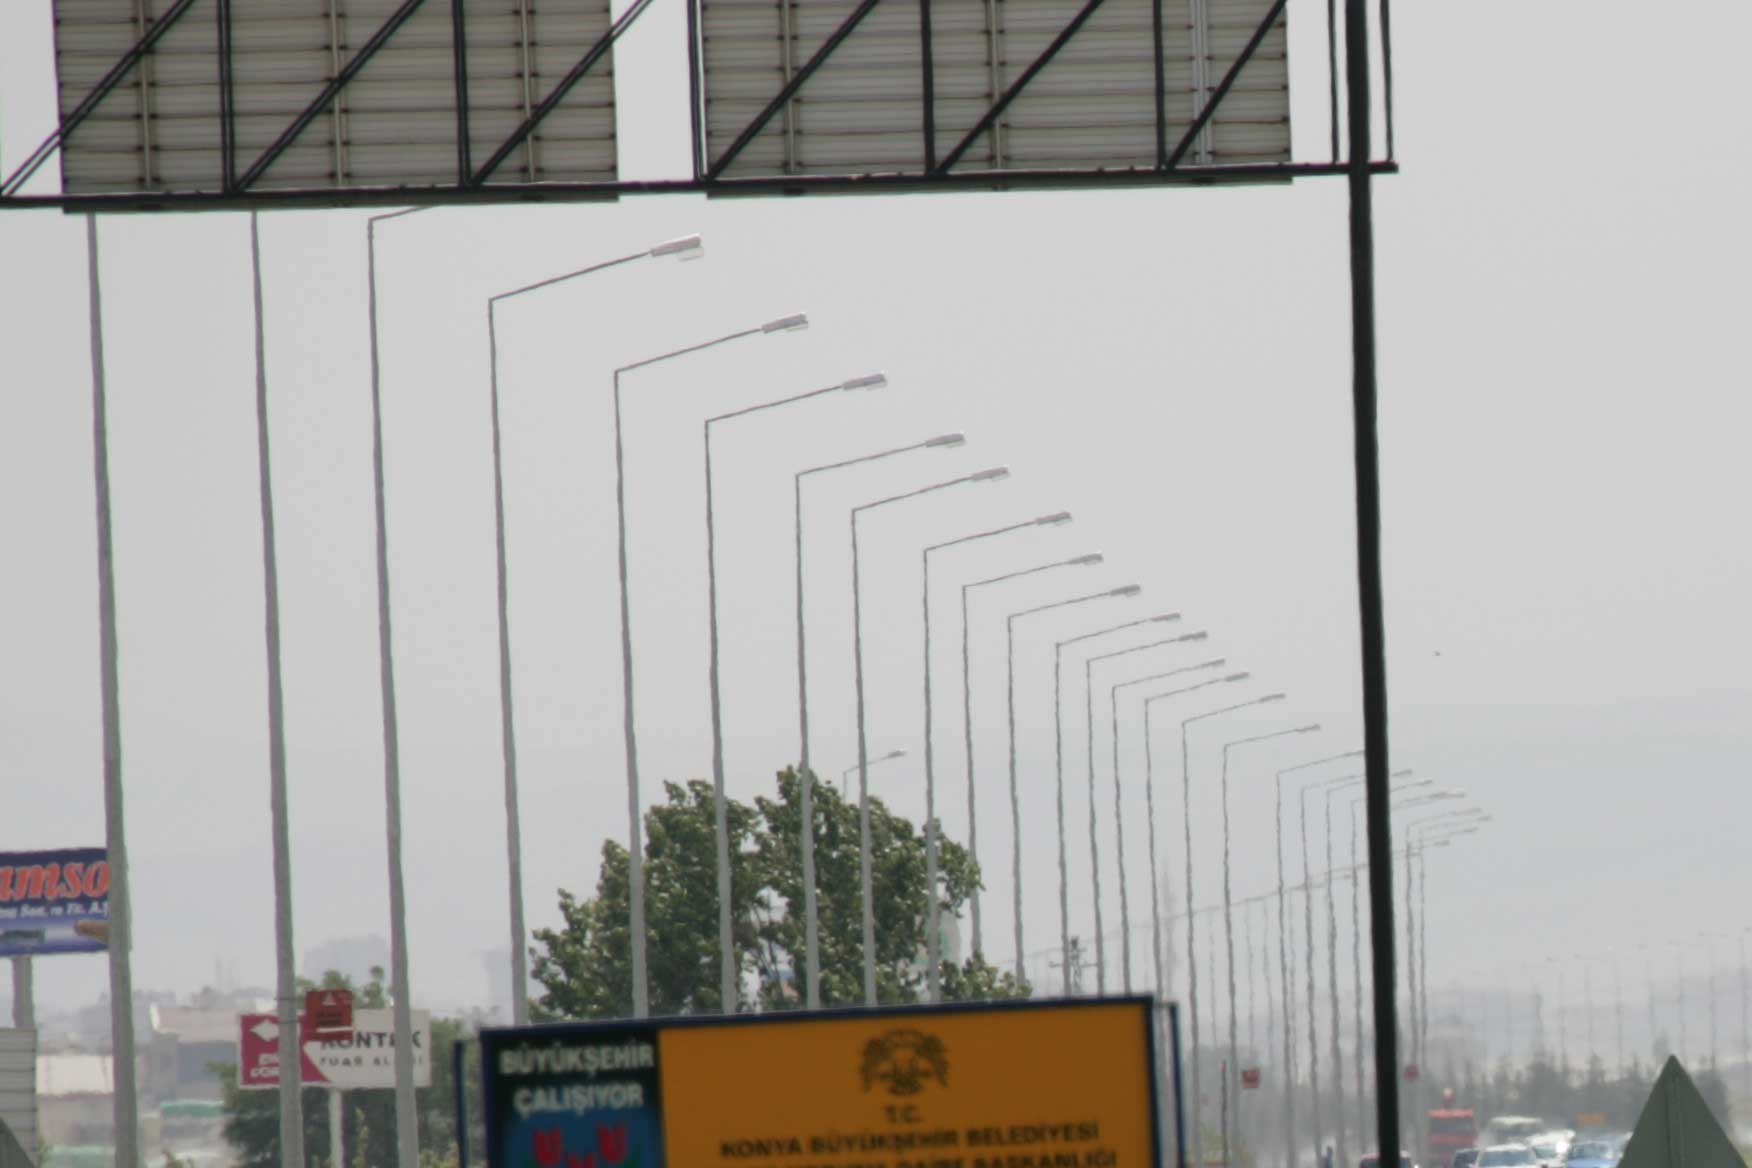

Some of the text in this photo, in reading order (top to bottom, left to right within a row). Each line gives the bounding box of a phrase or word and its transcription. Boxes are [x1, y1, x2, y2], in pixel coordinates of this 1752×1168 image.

[501, 1038, 654, 1077] BÜYÜKŞEHİR
[514, 1081, 643, 1119] ÇALIŞIYOR
[886, 1104, 922, 1123] T.C.
[721, 1119, 1098, 1158] KONYA BÜYÜKŞEHİR BELEDİYESİ
